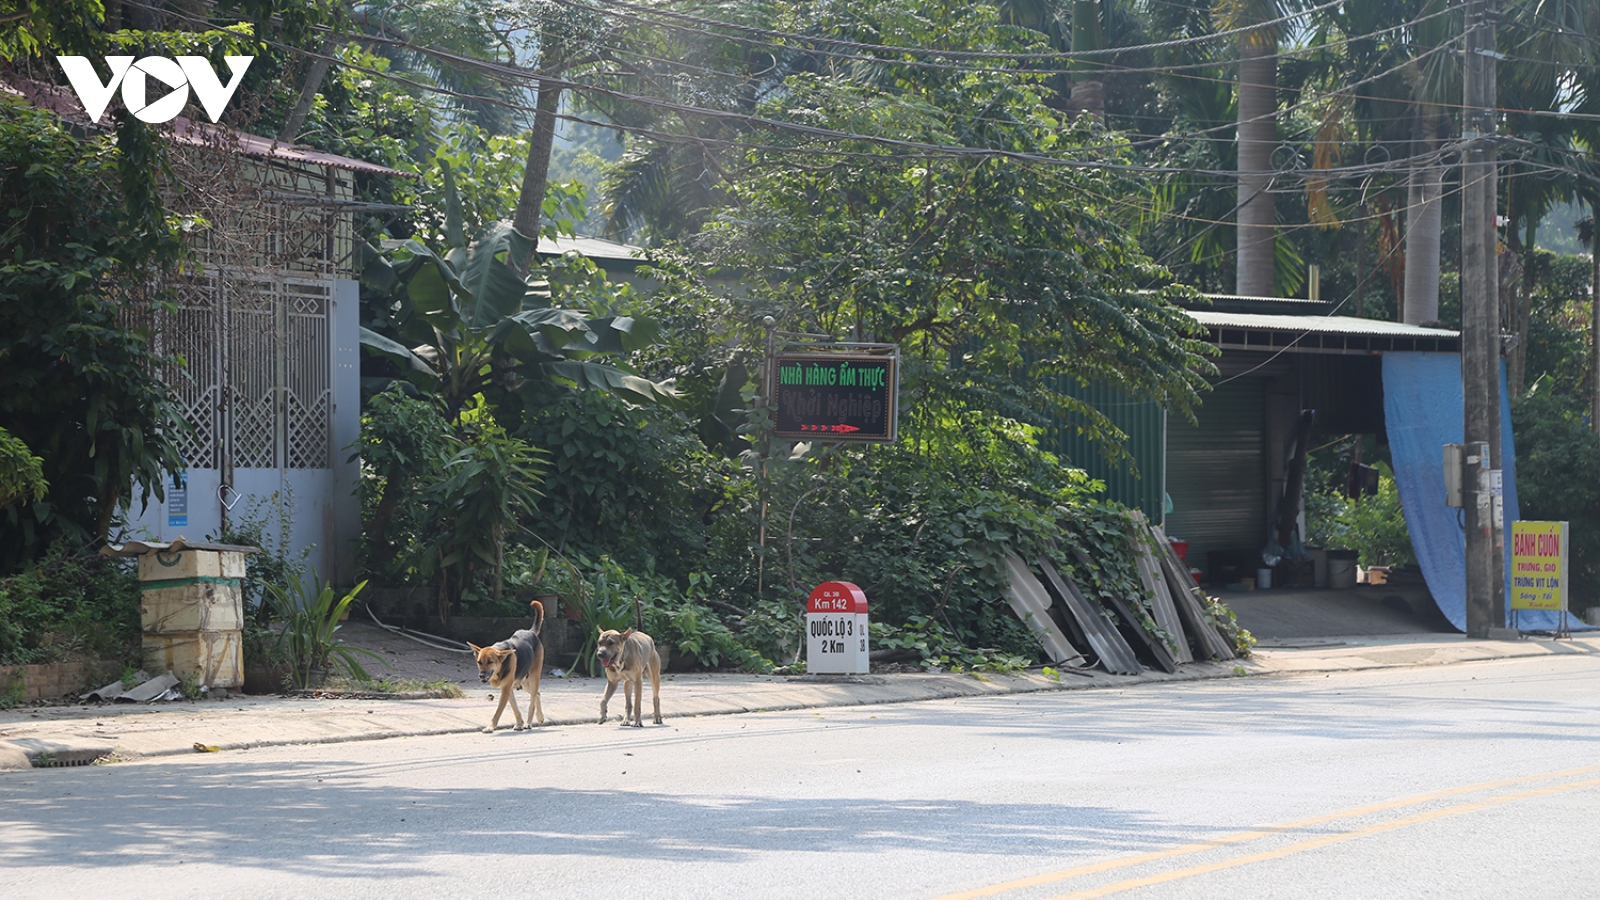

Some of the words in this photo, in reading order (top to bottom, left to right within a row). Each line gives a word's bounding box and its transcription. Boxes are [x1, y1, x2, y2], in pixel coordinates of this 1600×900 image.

[780, 362, 802, 385] NHÀ
[805, 362, 837, 386] HÀNG
[839, 361, 857, 387] ẨM
[858, 367, 885, 391] THỰC
[782, 389, 821, 422] Khởi
[826, 393, 881, 424] Nghiệp
[1514, 528, 1536, 557] BÁNH
[1537, 525, 1560, 557] CUỐN
[814, 598, 830, 610] Km
[831, 598, 847, 610] 142
[810, 615, 833, 639] QUỐC
[834, 617, 846, 639] LỘ
[847, 620, 853, 636] 3
[821, 639, 828, 654] 2
[829, 639, 845, 654] Km
